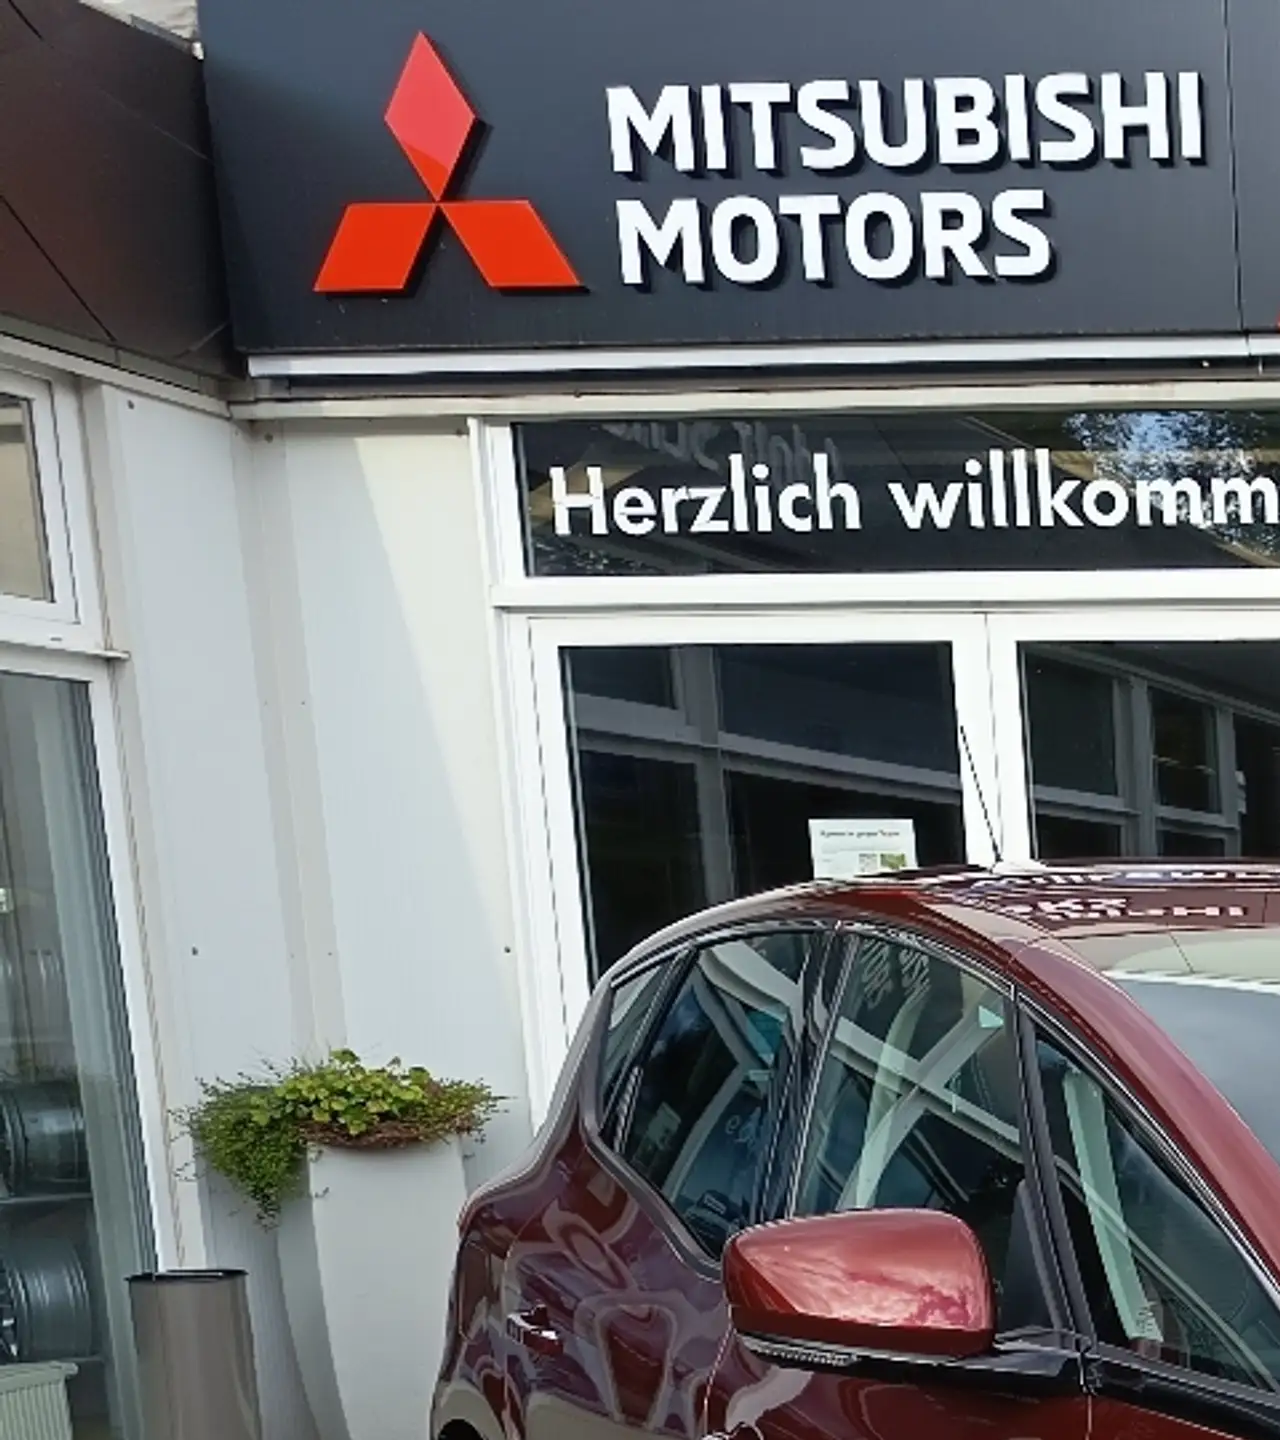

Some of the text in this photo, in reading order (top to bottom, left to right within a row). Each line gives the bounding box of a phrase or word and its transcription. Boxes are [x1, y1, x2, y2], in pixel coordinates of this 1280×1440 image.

[606, 72, 1203, 173] MITSUBISHI
[616, 188, 1052, 285] MOTORS
[549, 452, 862, 536] Herzlich
